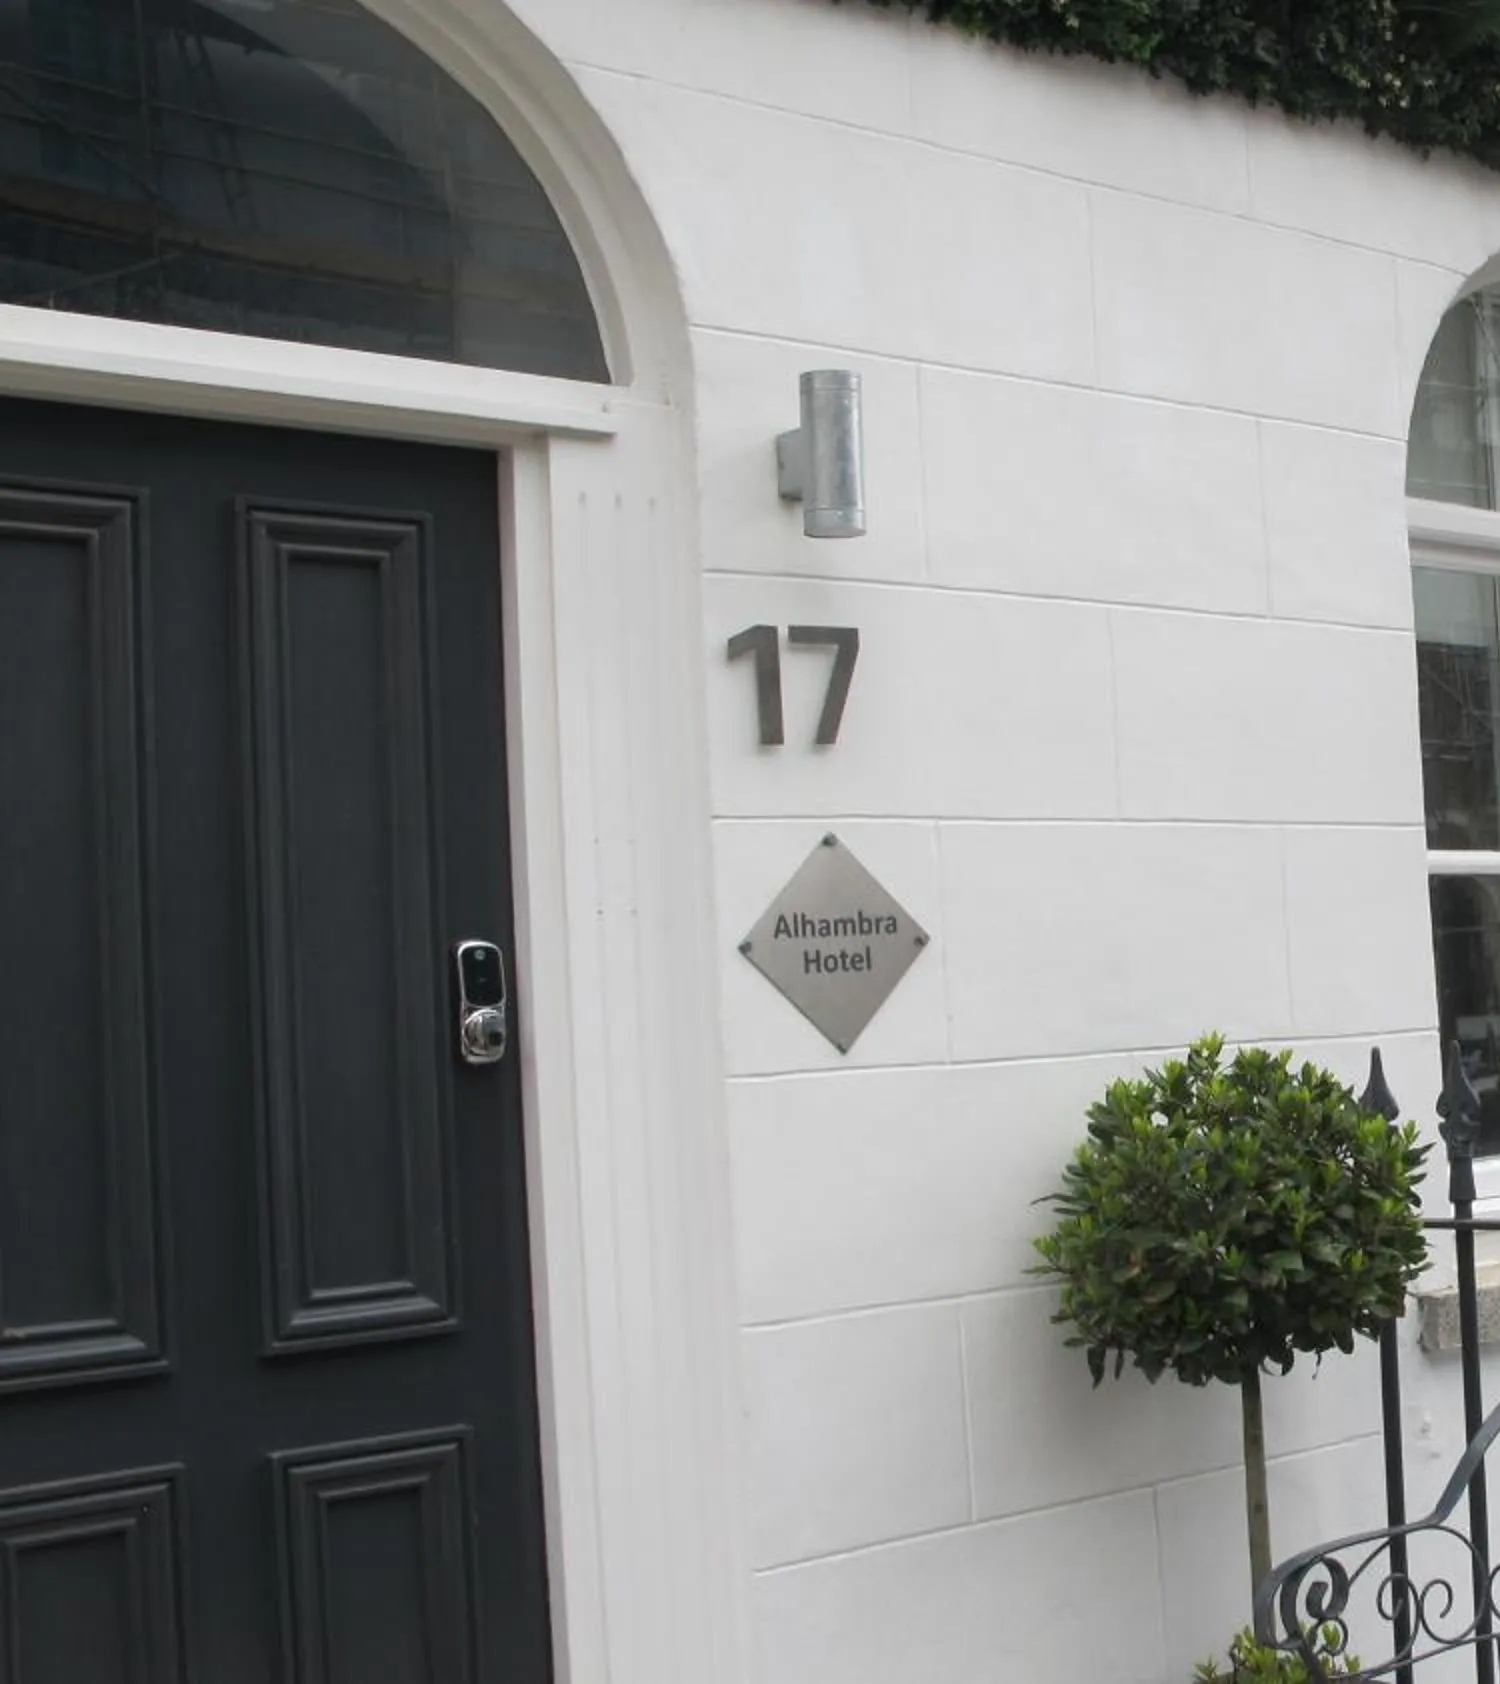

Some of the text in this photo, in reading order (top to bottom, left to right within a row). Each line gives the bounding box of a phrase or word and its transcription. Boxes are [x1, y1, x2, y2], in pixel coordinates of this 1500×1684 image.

[726, 624, 860, 746] 17
[773, 911, 898, 939] Alhambra
[803, 946, 872, 974] Hotel
